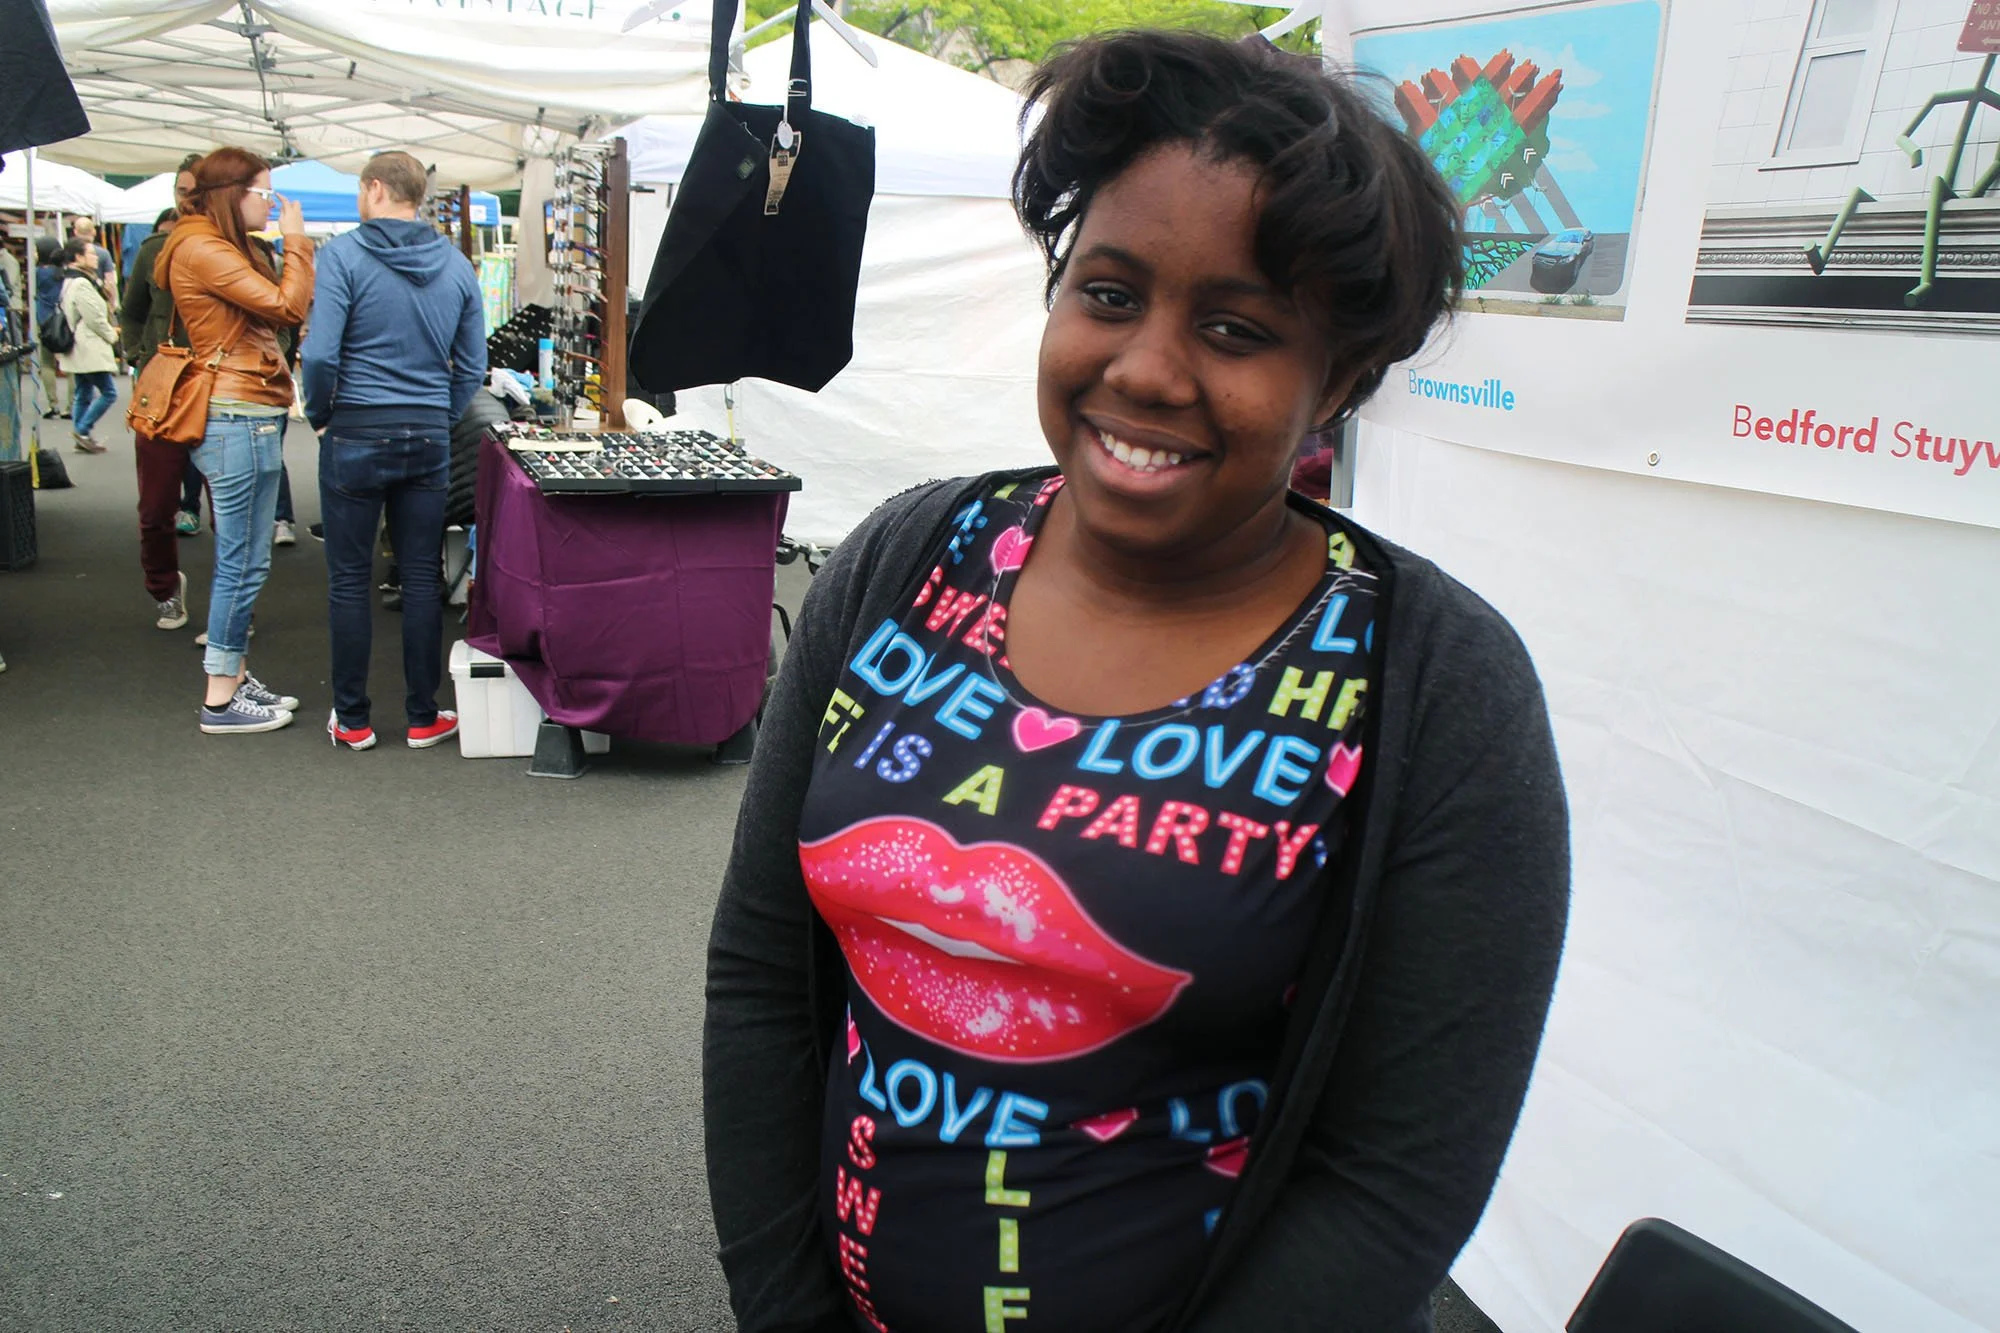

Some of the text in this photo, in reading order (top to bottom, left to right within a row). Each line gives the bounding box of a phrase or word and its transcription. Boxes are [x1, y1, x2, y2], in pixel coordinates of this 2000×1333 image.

[1409, 369, 1515, 411] Brownsville
[1733, 405, 1879, 453] Bedford
[850, 617, 1321, 806] LOVE LOVE
[854, 720, 933, 784] IS
[942, 764, 1005, 816] A
[1037, 783, 1319, 881] PARTY
[859, 1038, 1049, 1147] LOVE
